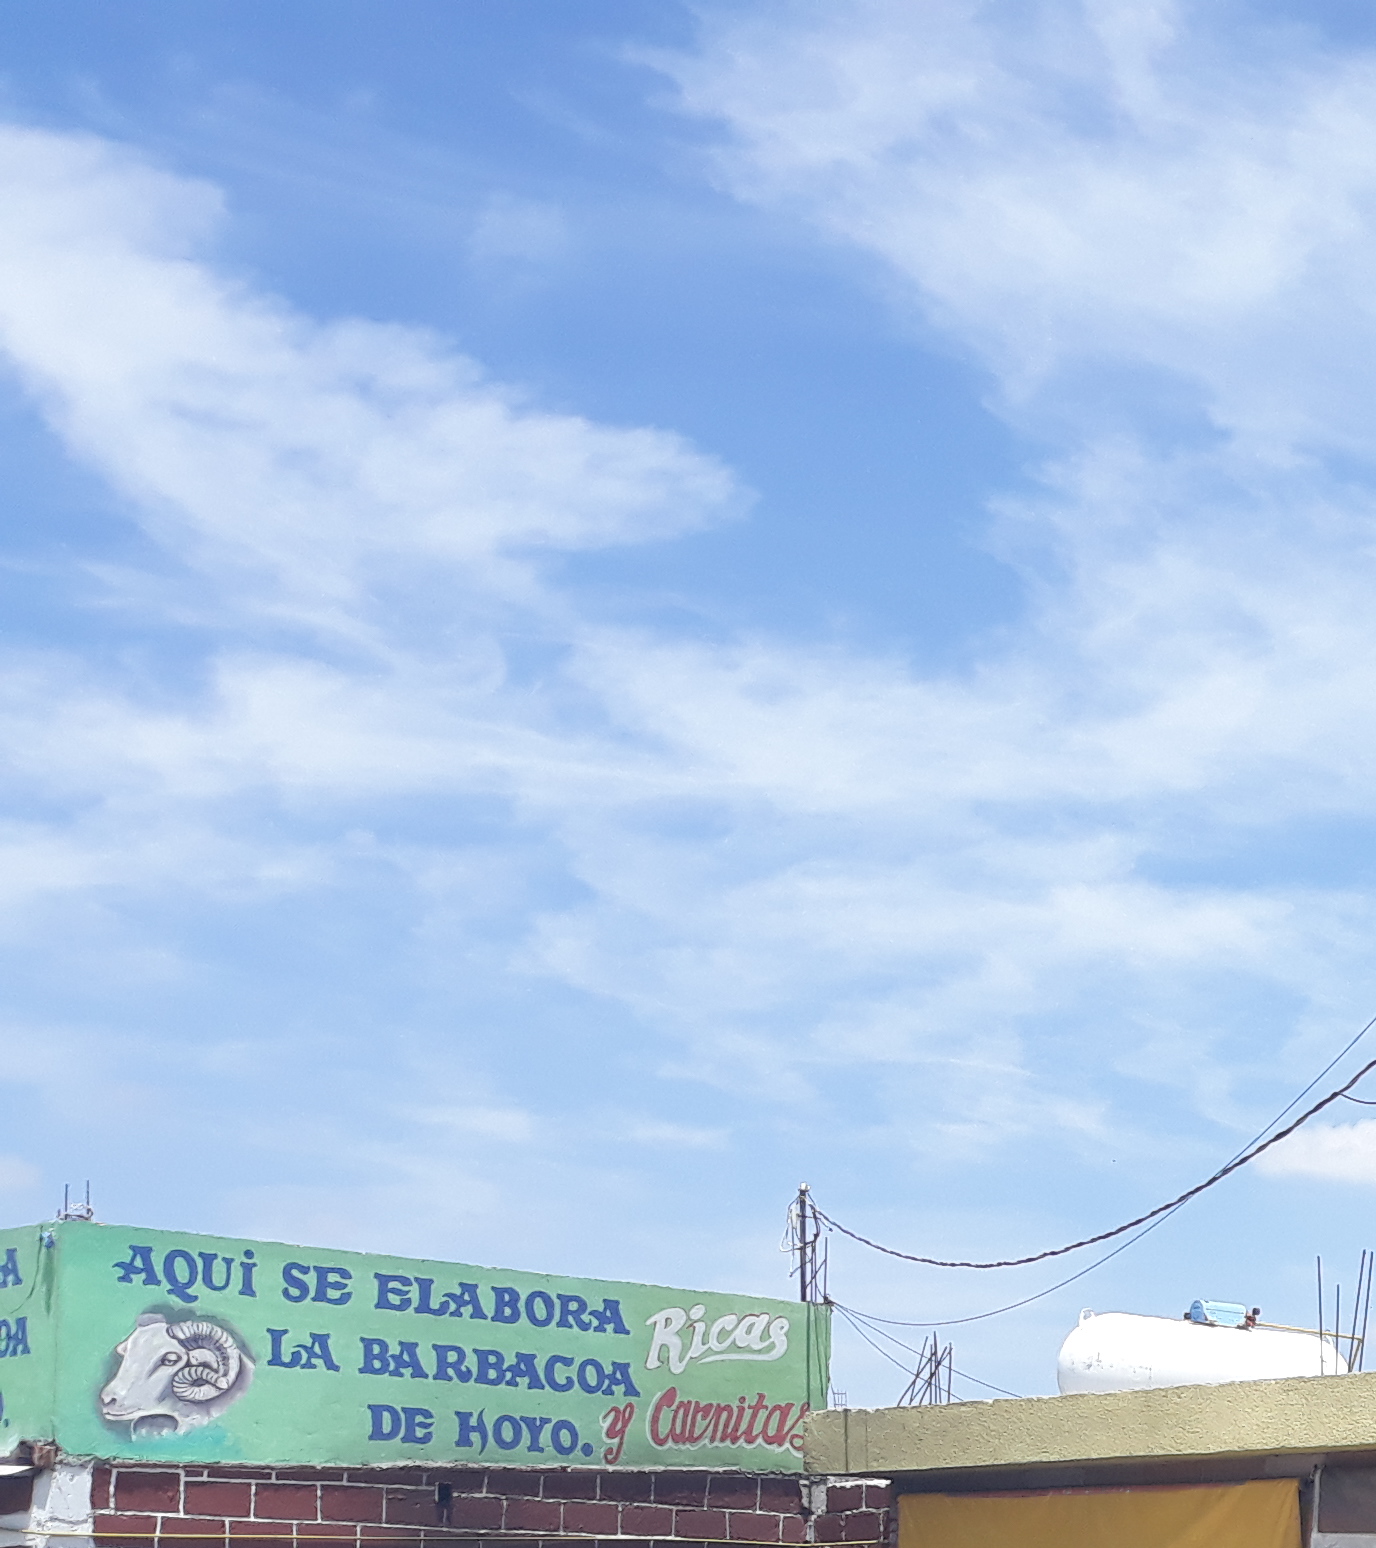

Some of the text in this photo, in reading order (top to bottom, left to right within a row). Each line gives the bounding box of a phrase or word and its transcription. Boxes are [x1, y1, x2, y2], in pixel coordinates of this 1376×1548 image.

[282, 1262, 353, 1305] SE
[373, 1272, 630, 1335] ELABORA
[266, 1328, 640, 1397] LA BARBACOA
[645, 1304, 790, 1375] Ricas
[368, 1404, 436, 1444] DE
[650, 1386, 809, 1452] Carnitas
